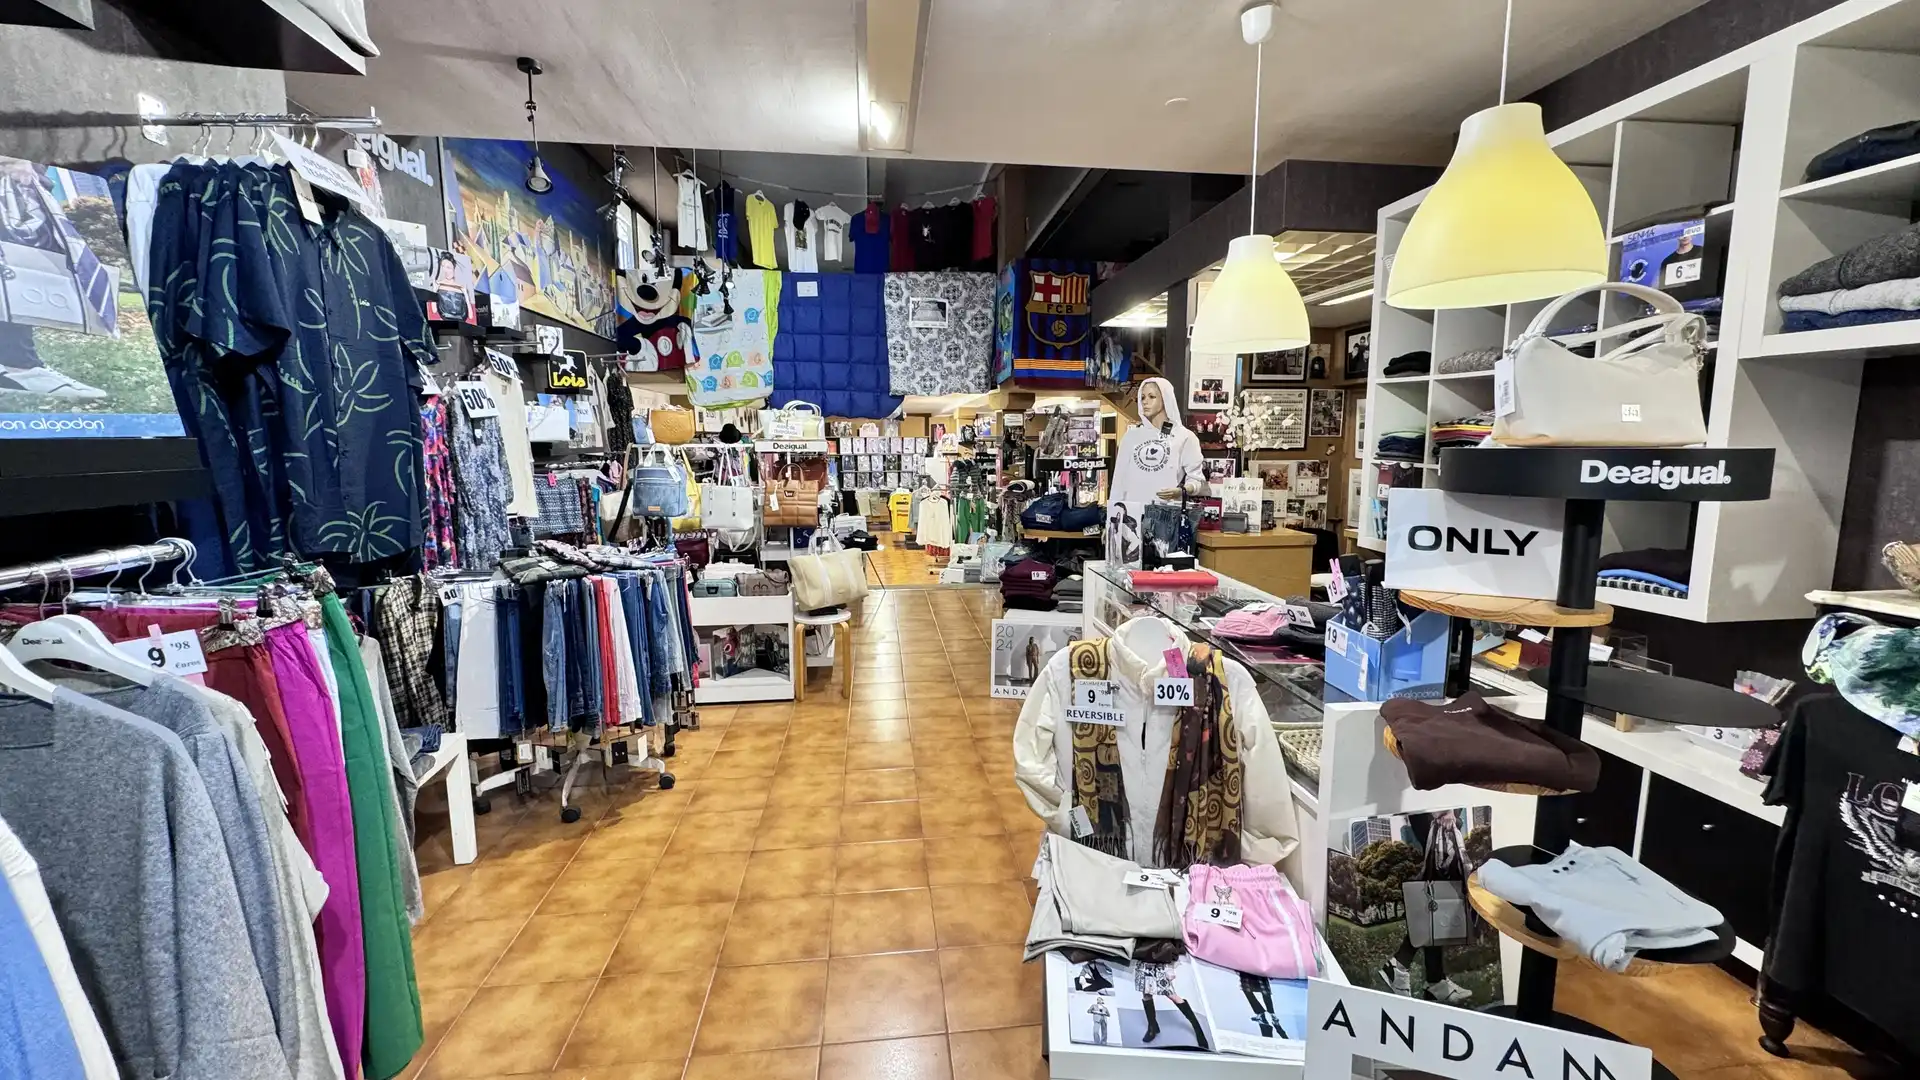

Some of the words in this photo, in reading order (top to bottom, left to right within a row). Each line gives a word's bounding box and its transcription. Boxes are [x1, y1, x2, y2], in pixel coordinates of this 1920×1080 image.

[1675, 265, 1684, 279] 6
[1046, 303, 1074, 314] FCB
[490, 353, 521, 378] 50%
[553, 371, 586, 387] Lois
[462, 387, 496, 411] 50%
[1407, 525, 1539, 557] ONLY
[1327, 580, 1337, 597] 19
[1286, 608, 1297, 622] 9
[996, 625, 1015, 638] 20
[1327, 626, 1338, 644] 19
[996, 638, 1014, 651] 24
[148, 647, 166, 668] 9
[993, 688, 1027, 697] ANDA
[1087, 689, 1096, 704] 9
[1156, 684, 1190, 702] 30%
[1066, 709, 1125, 722] REVERSIBLE
[1713, 728, 1724, 740] 3
[1139, 874, 1150, 883] 9
[1210, 907, 1221, 919] 9
